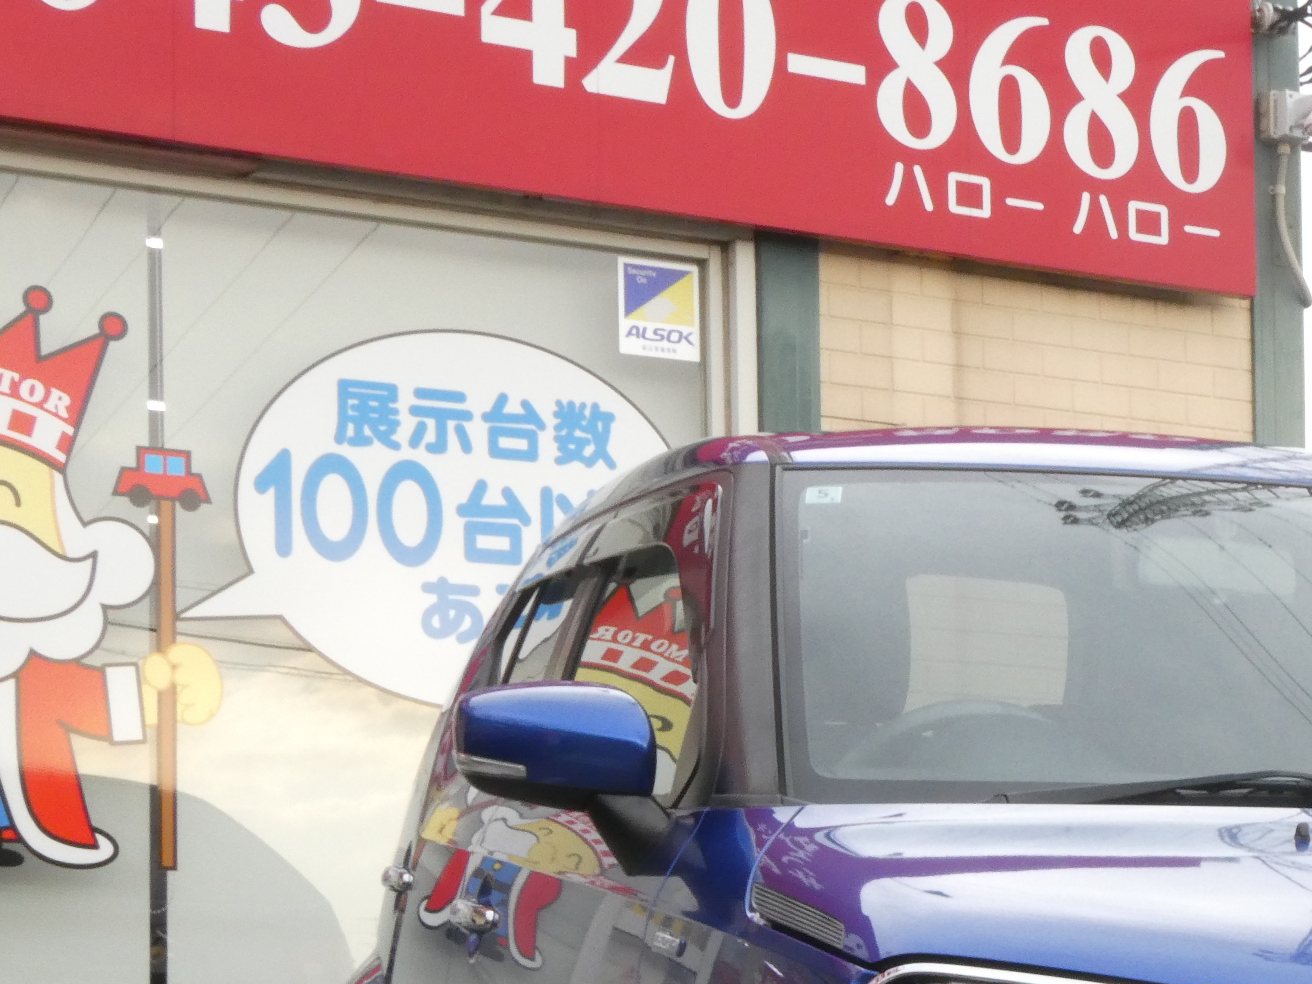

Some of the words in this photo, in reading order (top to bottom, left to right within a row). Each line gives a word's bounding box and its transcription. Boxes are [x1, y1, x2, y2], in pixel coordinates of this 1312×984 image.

[38, 0, 1226, 193] -420-8686
[885, 162, 1044, 218] ハロー
[1073, 192, 1220, 245] ハロー
[625, 325, 694, 346] ALSOK
[334, 378, 617, 470] 展示台数
[421, 576, 515, 644] あ
